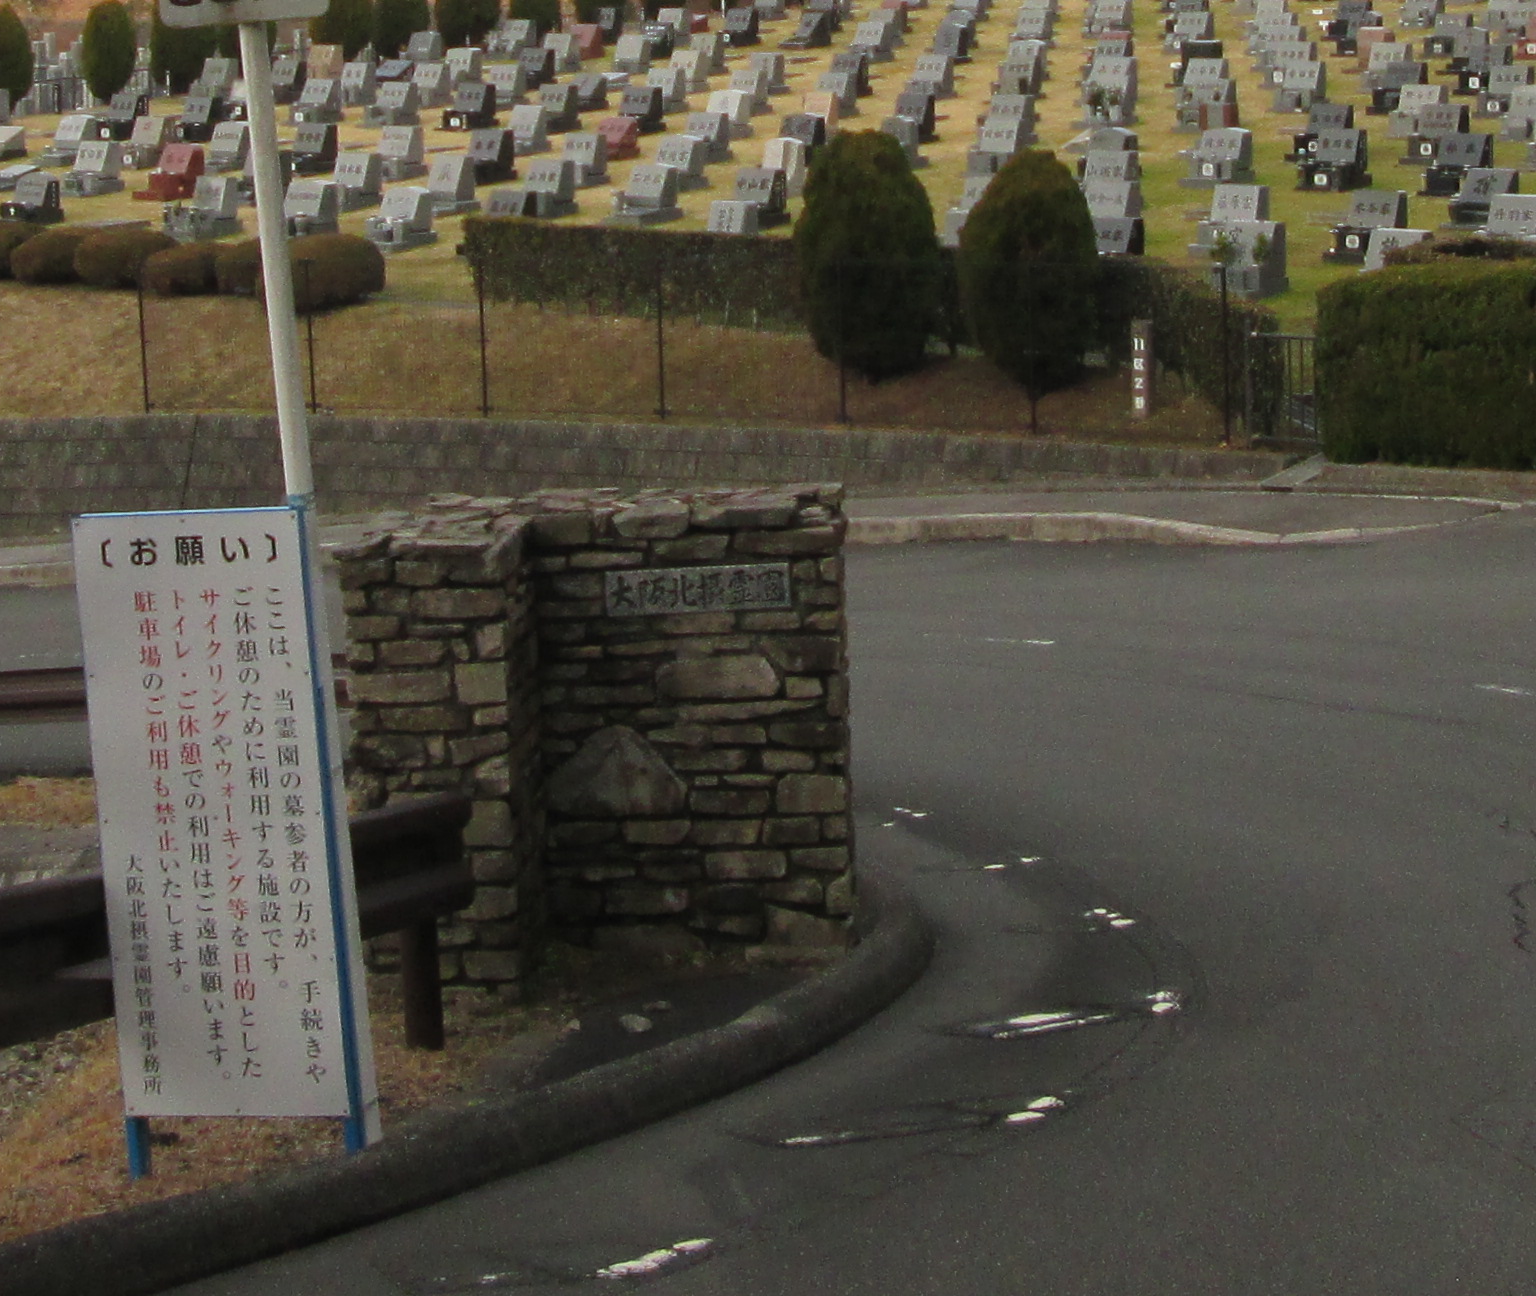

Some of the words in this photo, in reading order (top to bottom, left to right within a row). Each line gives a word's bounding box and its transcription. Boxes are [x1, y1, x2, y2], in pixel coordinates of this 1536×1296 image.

[133, 590, 192, 994] 駐車場のご利用も禁止いたします。
[233, 585, 288, 989] ご休憩のために利用する施設です。
